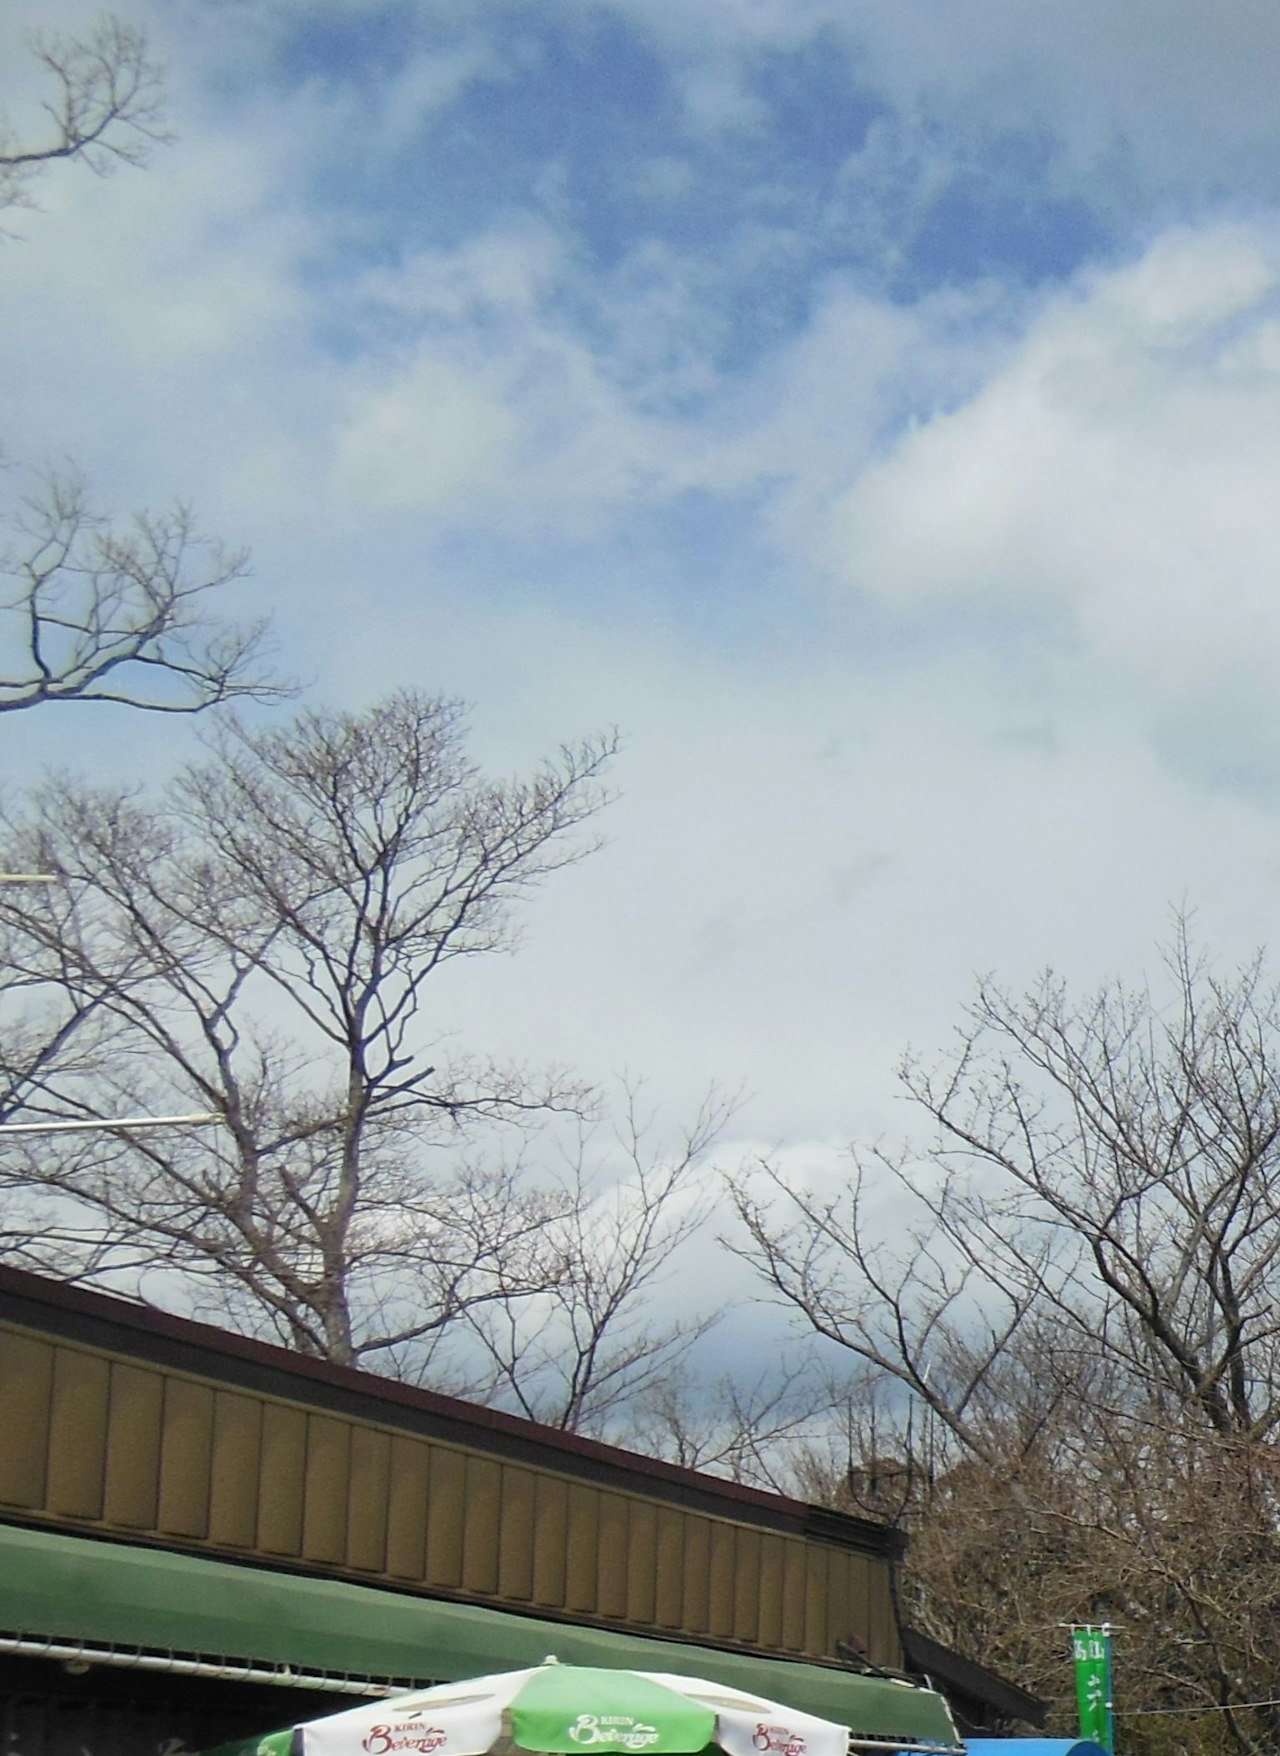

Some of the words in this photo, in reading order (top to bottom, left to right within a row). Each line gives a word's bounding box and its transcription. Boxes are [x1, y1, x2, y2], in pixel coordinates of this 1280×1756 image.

[394, 1722, 427, 1733] KIRIN
[569, 1714, 658, 1749] Beverage
[600, 1715, 634, 1726] KIRIN
[362, 1724, 447, 1754] Beverage
[753, 1723, 808, 1756] Beverage
